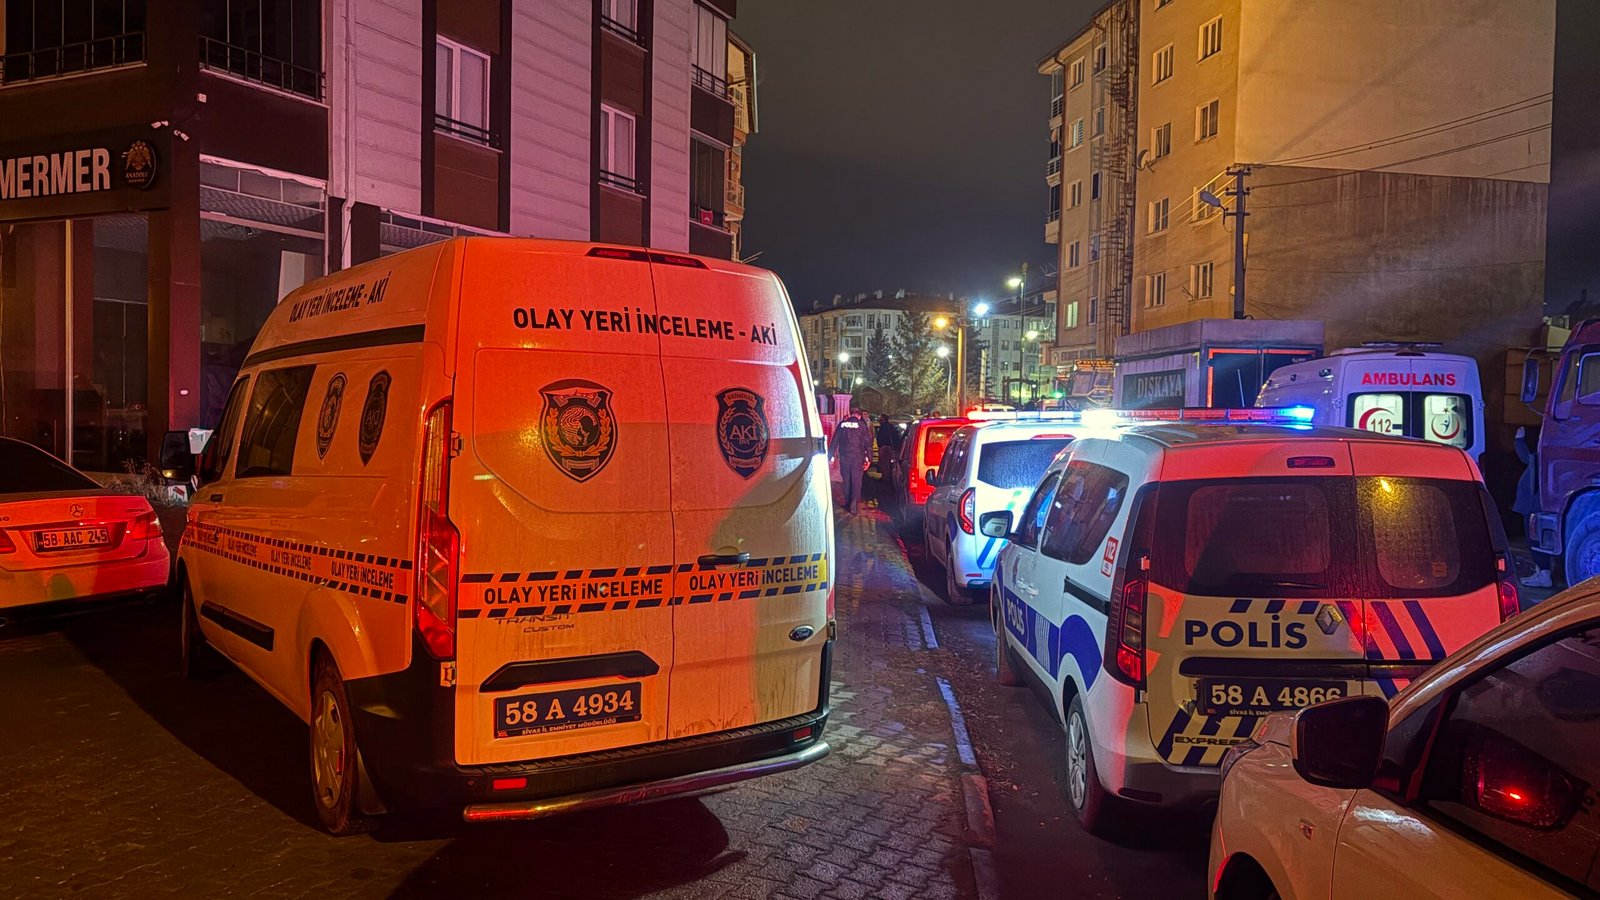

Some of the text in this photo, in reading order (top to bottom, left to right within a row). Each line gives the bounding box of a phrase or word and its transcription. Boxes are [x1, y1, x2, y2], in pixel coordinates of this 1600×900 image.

[0, 147, 110, 199] MERMER
[289, 300, 306, 322] OLAY
[513, 307, 574, 329] OLAY
[580, 306, 631, 332] YERİ
[637, 307, 735, 341] İNCELEME
[751, 322, 777, 346] AKİ
[1361, 372, 1456, 386] AMBULANS
[1370, 418, 1392, 433] 112
[44, 530, 107, 546] 58 AAC 245
[331, 561, 346, 577] OLAY
[689, 573, 726, 591] OLAY
[484, 586, 533, 604] OLAY
[523, 624, 575, 633] CUSTOM
[1185, 614, 1307, 649] POLİS
[1211, 684, 1341, 707] 58 A 4866
[505, 690, 634, 725] 58 A 4934
